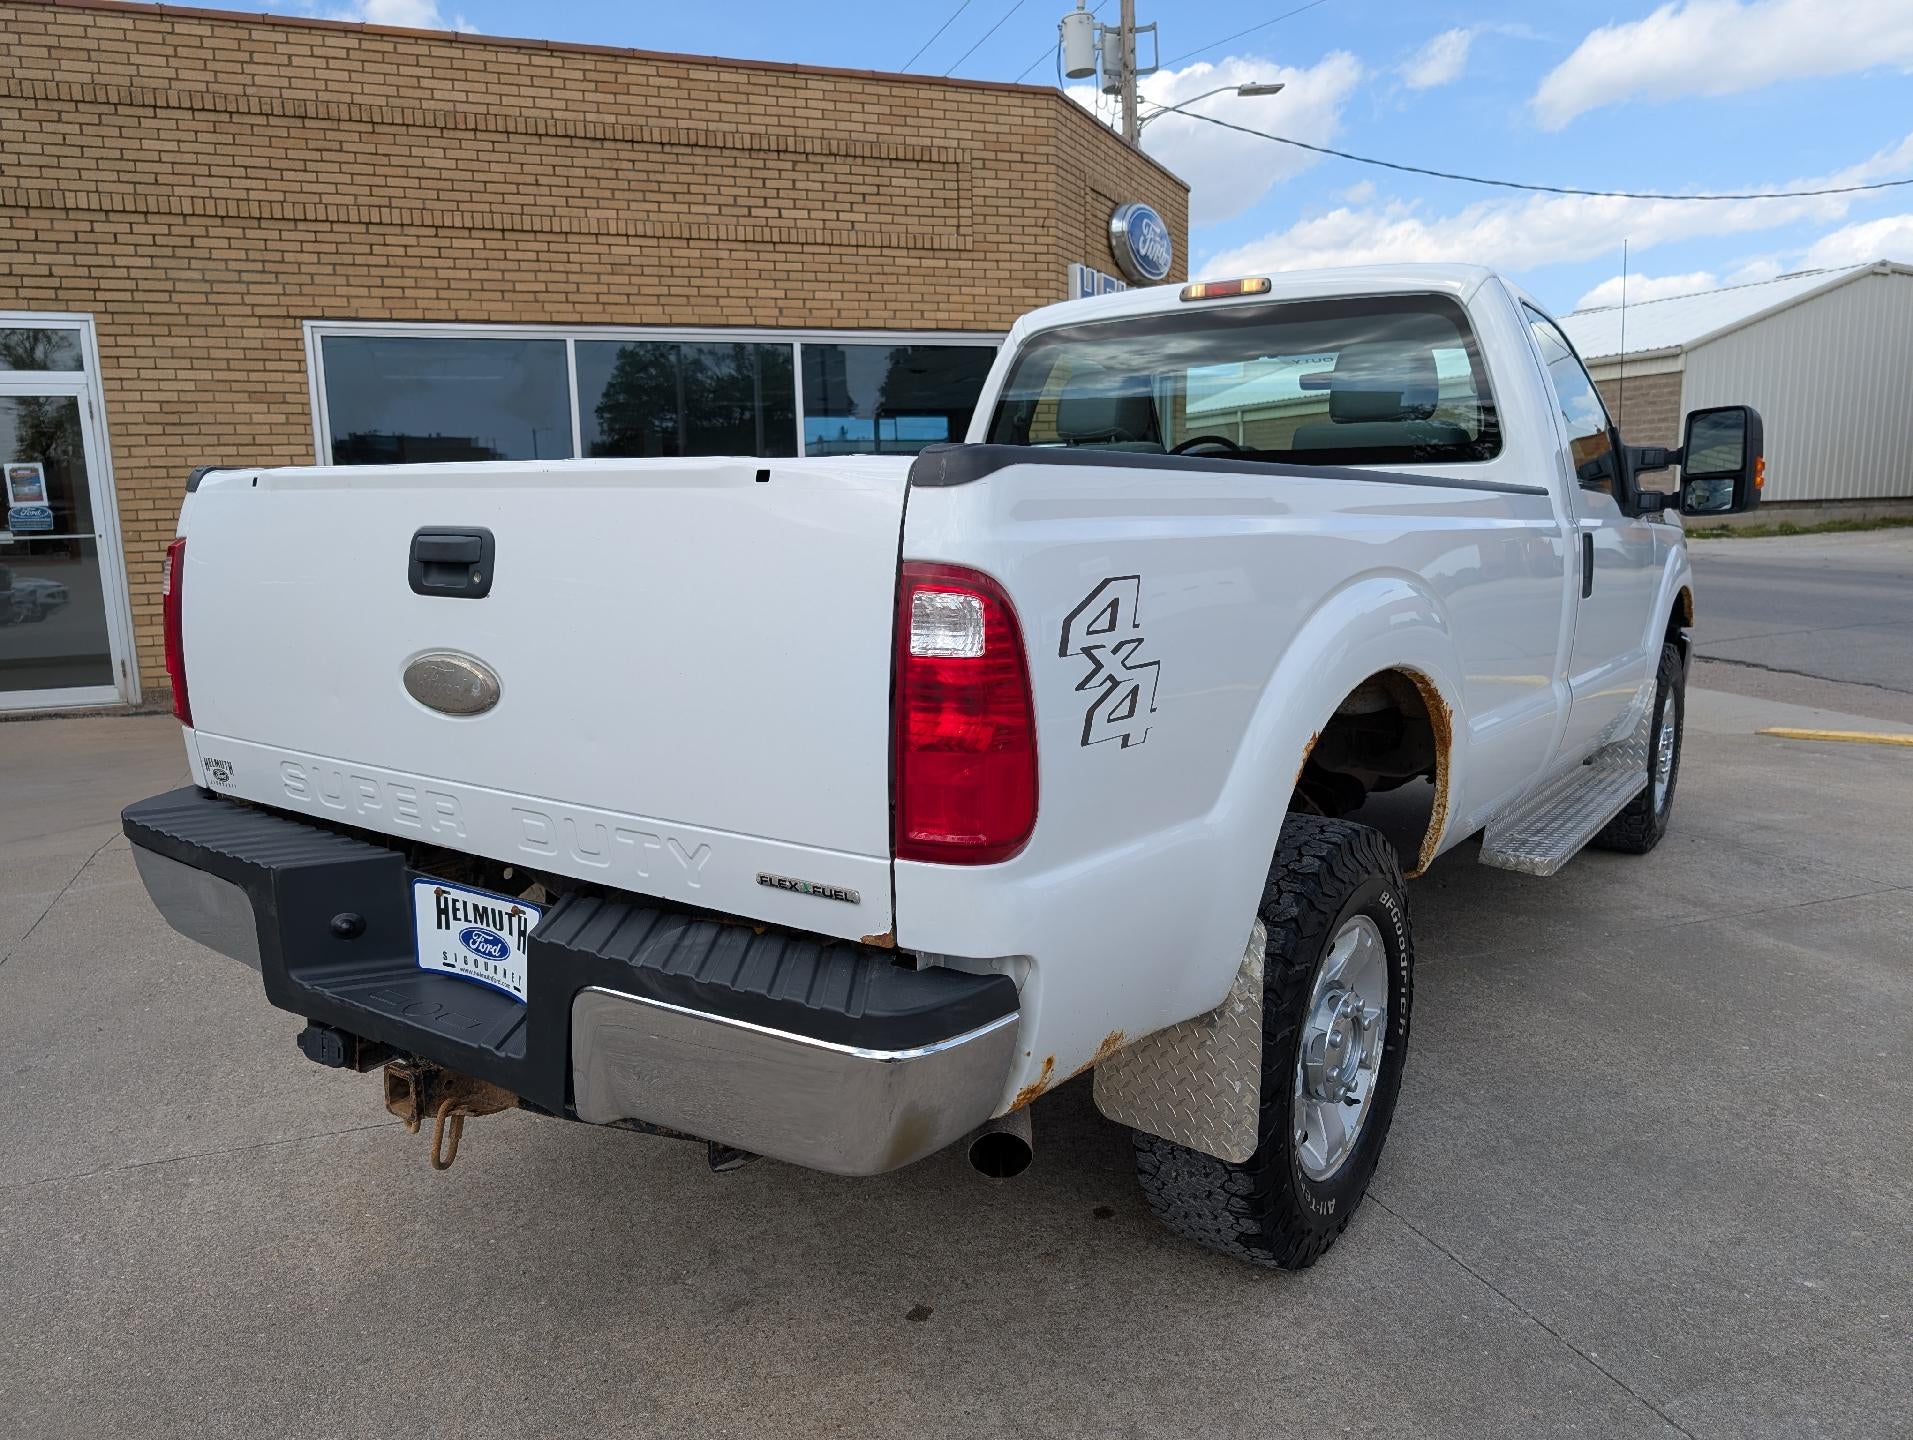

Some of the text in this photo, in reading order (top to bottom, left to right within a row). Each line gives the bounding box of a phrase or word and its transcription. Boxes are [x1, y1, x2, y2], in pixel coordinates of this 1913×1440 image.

[1139, 218, 1170, 267] Ford
[20, 507, 42, 516] Ford
[279, 760, 713, 888] SUPER DUTY
[759, 875, 857, 904] FLEX FUEL
[435, 893, 528, 955] HELMUTH
[469, 931, 501, 957] Ford
